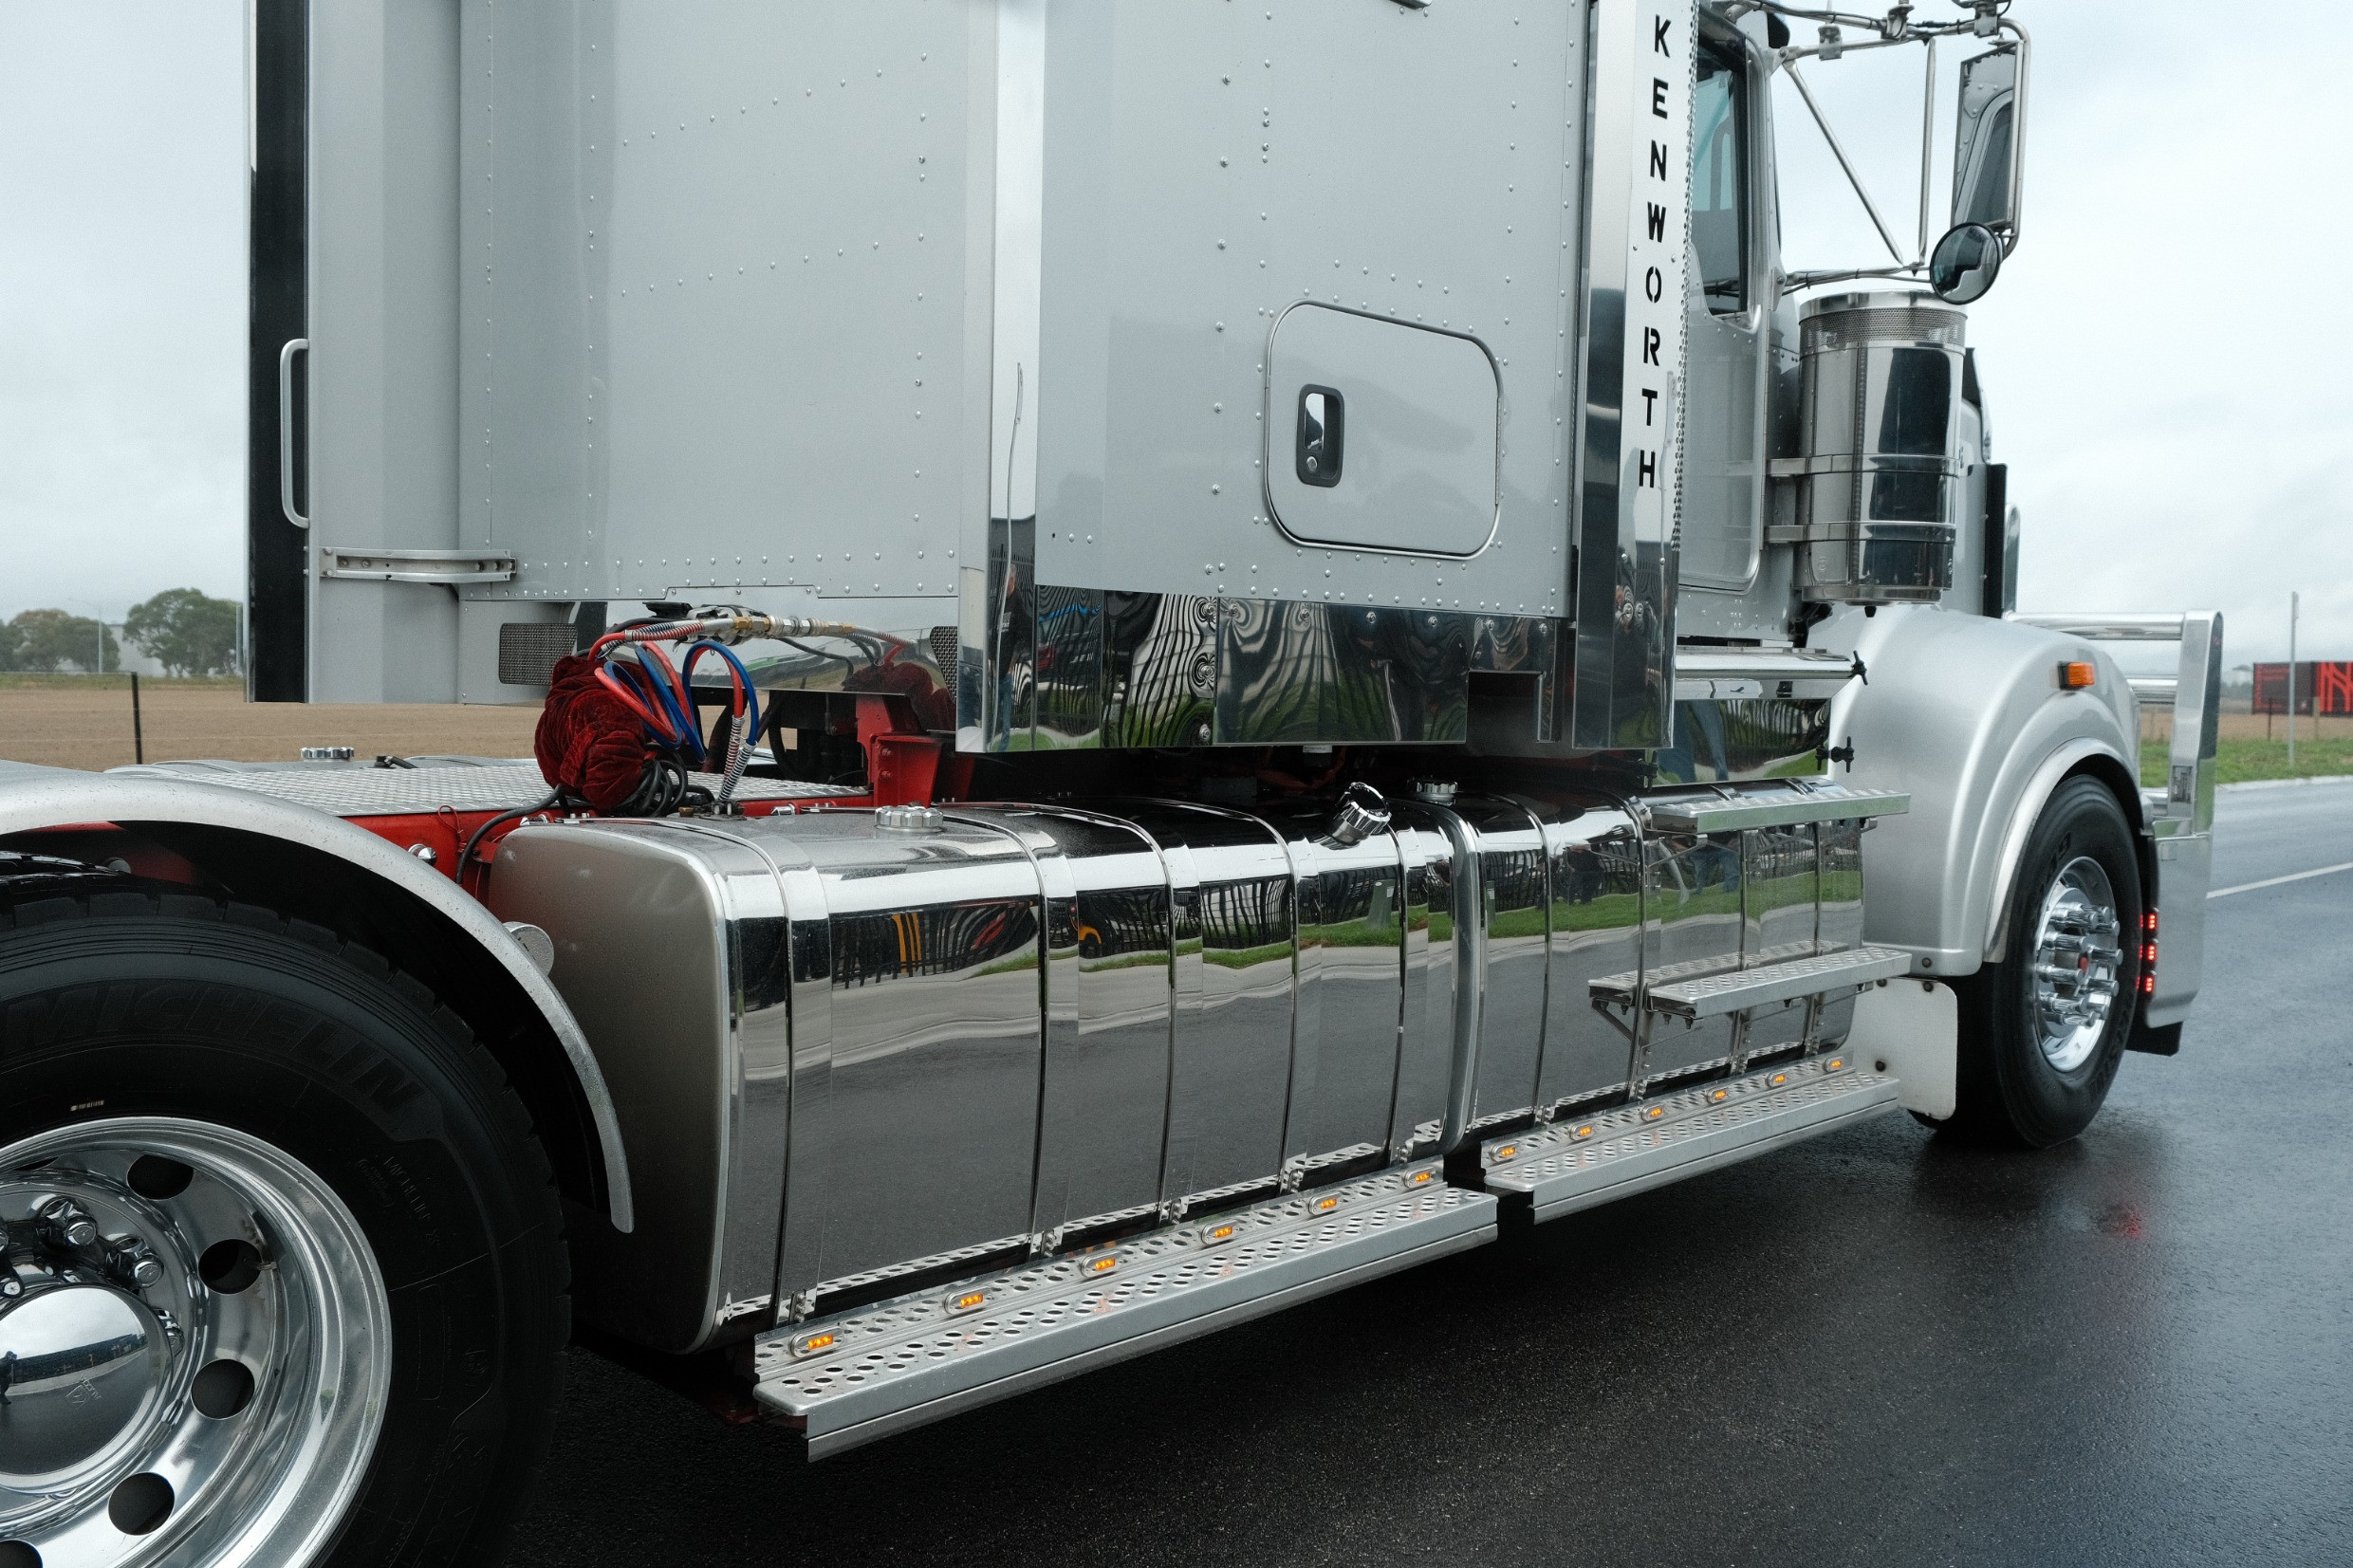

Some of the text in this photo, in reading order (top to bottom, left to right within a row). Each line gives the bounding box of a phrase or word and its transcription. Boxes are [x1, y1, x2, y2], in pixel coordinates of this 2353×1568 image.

[1639, 14, 1672, 489] KENWORTH
[1, 983, 424, 1112] MICHELIN
[80, 1373, 102, 1399] ALCOA
